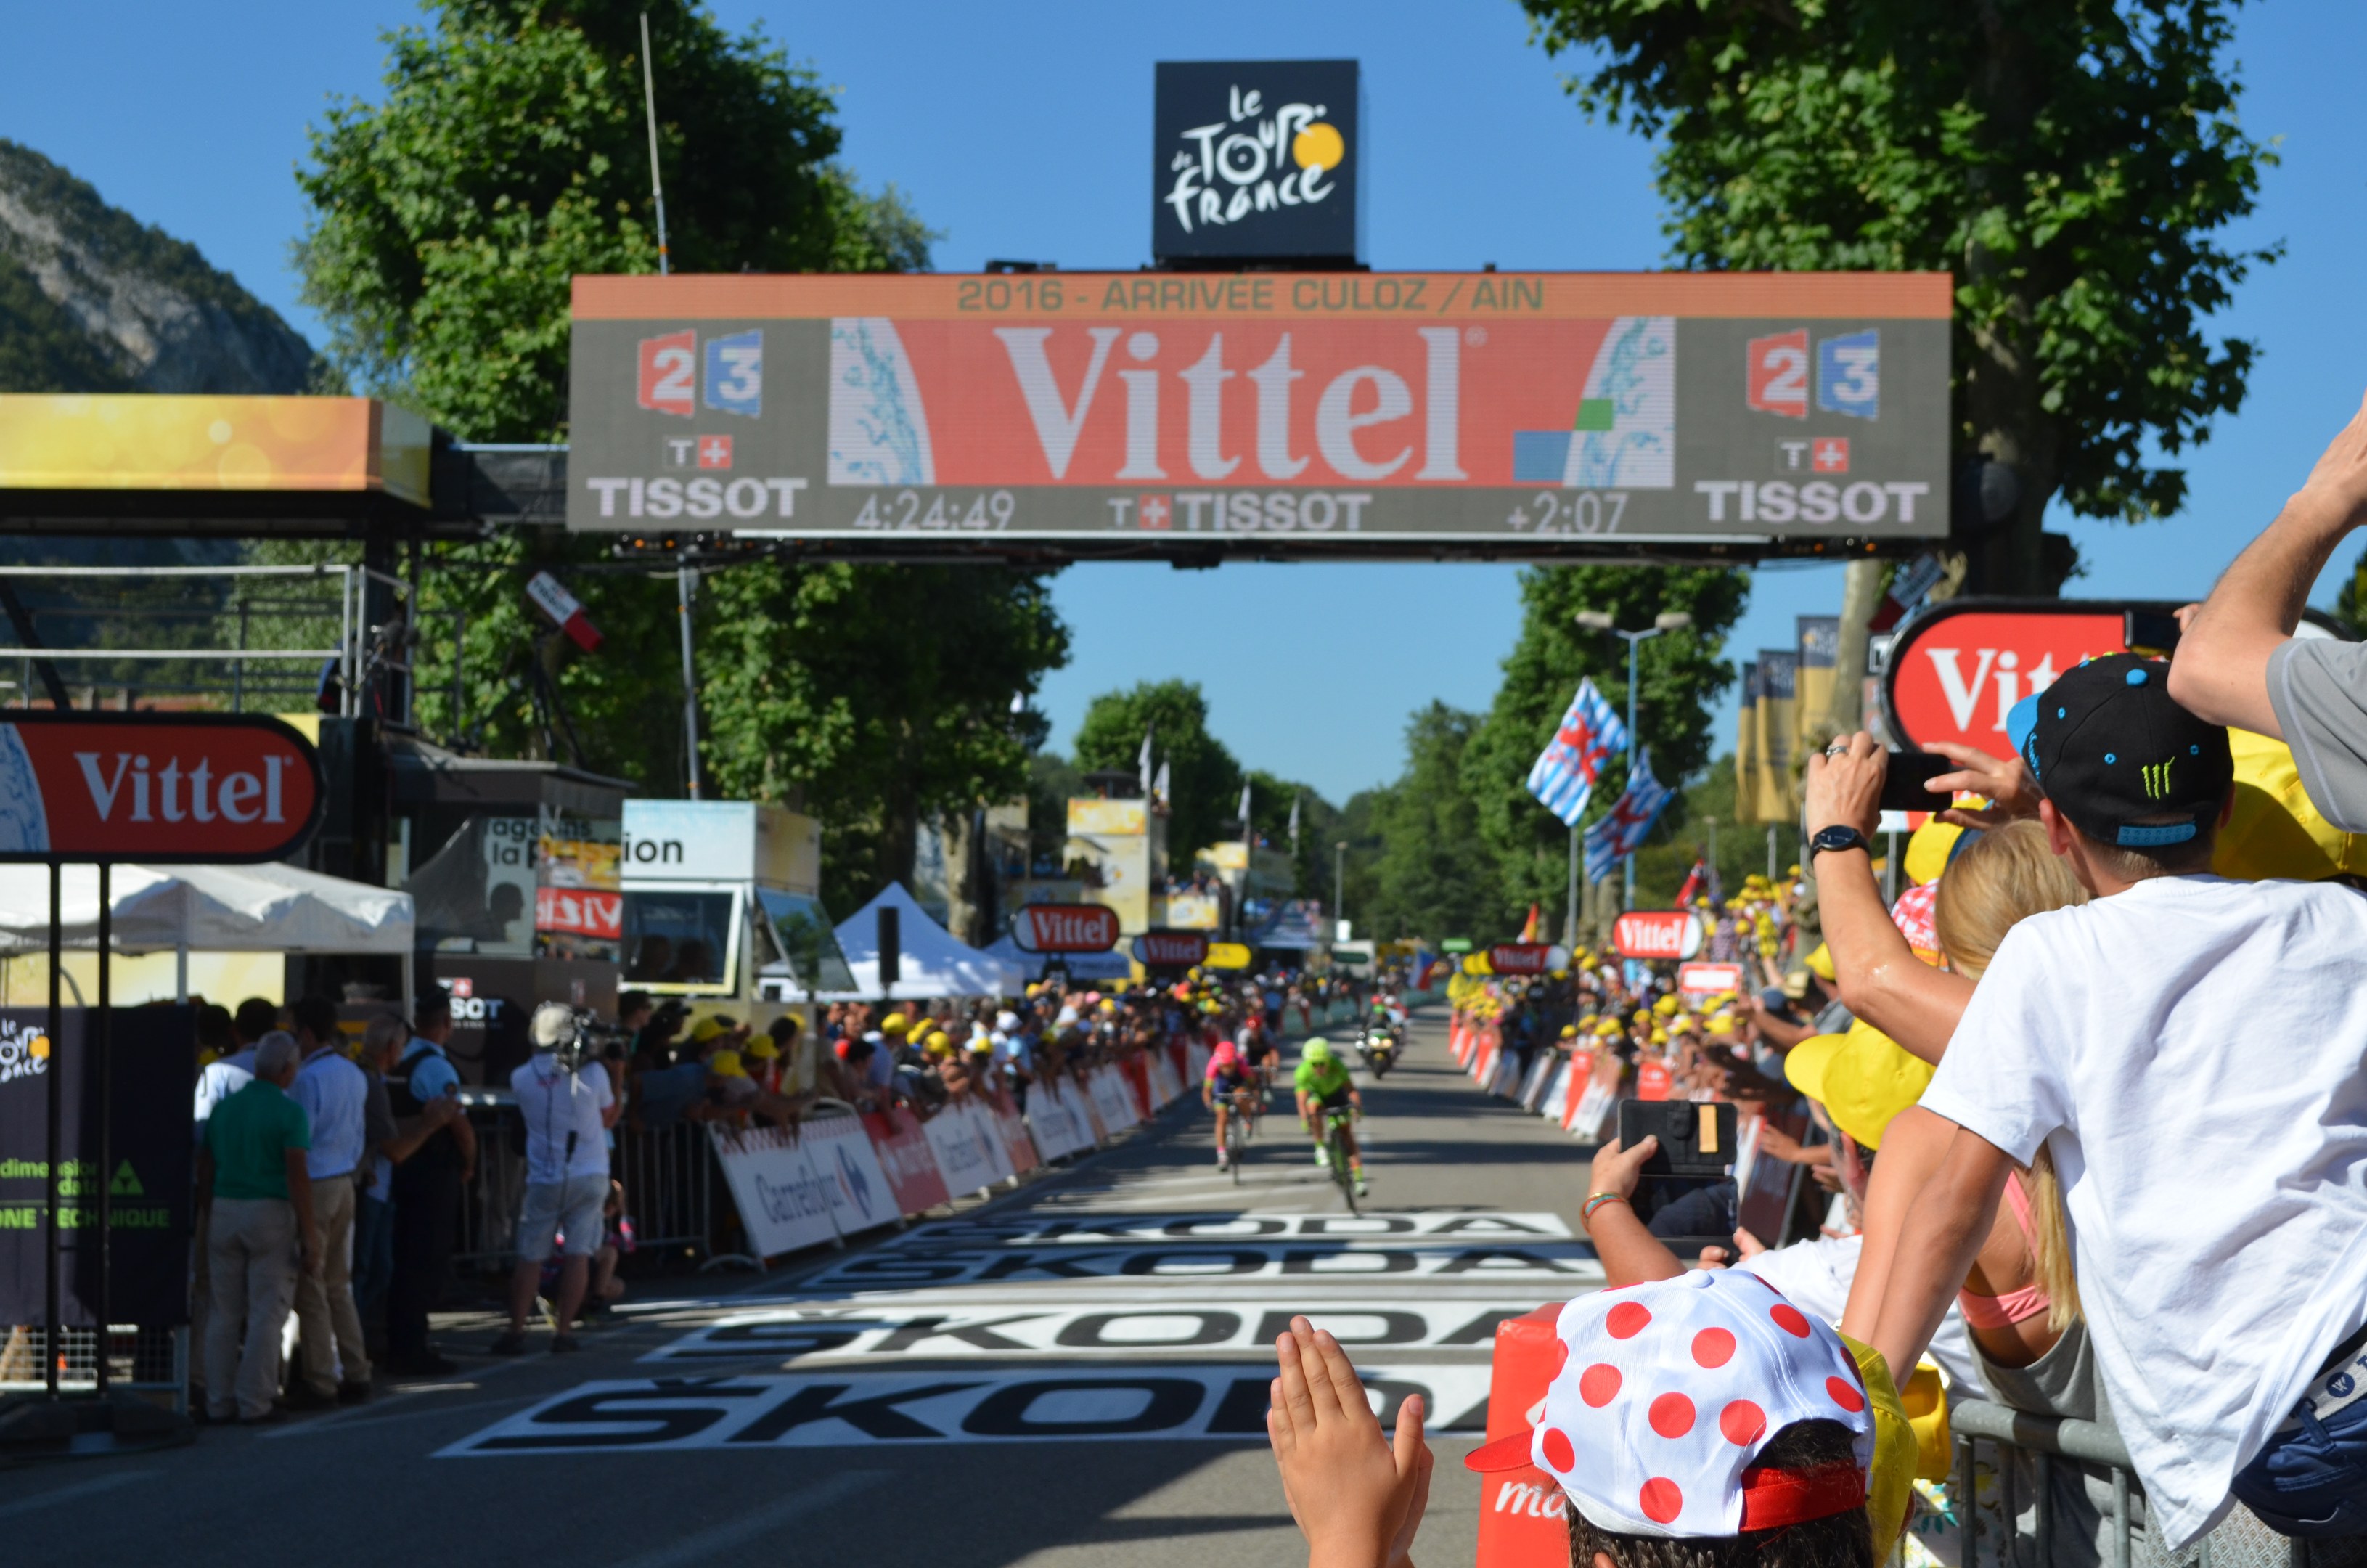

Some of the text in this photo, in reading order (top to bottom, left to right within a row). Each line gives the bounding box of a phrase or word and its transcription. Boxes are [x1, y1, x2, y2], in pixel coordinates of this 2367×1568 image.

[958, 279, 1072, 312] 2016
[1101, 273, 1275, 311] ARRIVÉE
[1292, 278, 1428, 311] CULOZ
[652, 347, 761, 401] 2 3
[1762, 347, 1879, 401] 2 3
[993, 327, 1468, 481] Vittel
[586, 477, 808, 519] TISSOT
[853, 491, 1018, 531] 4:24:49
[1177, 492, 1373, 533] TISSOT
[1508, 492, 1630, 534] +2:07
[1694, 481, 1929, 523] TISSOT
[74, 752, 287, 824] Vittel
[1034, 912, 1111, 944] Vittel
[1147, 937, 1203, 959] Vittel
[1619, 917, 1683, 952] Vittel
[449, 997, 504, 1021] SOT
[0, 1054, 48, 1084] ance
[1494, 1479, 1568, 1518] ma
